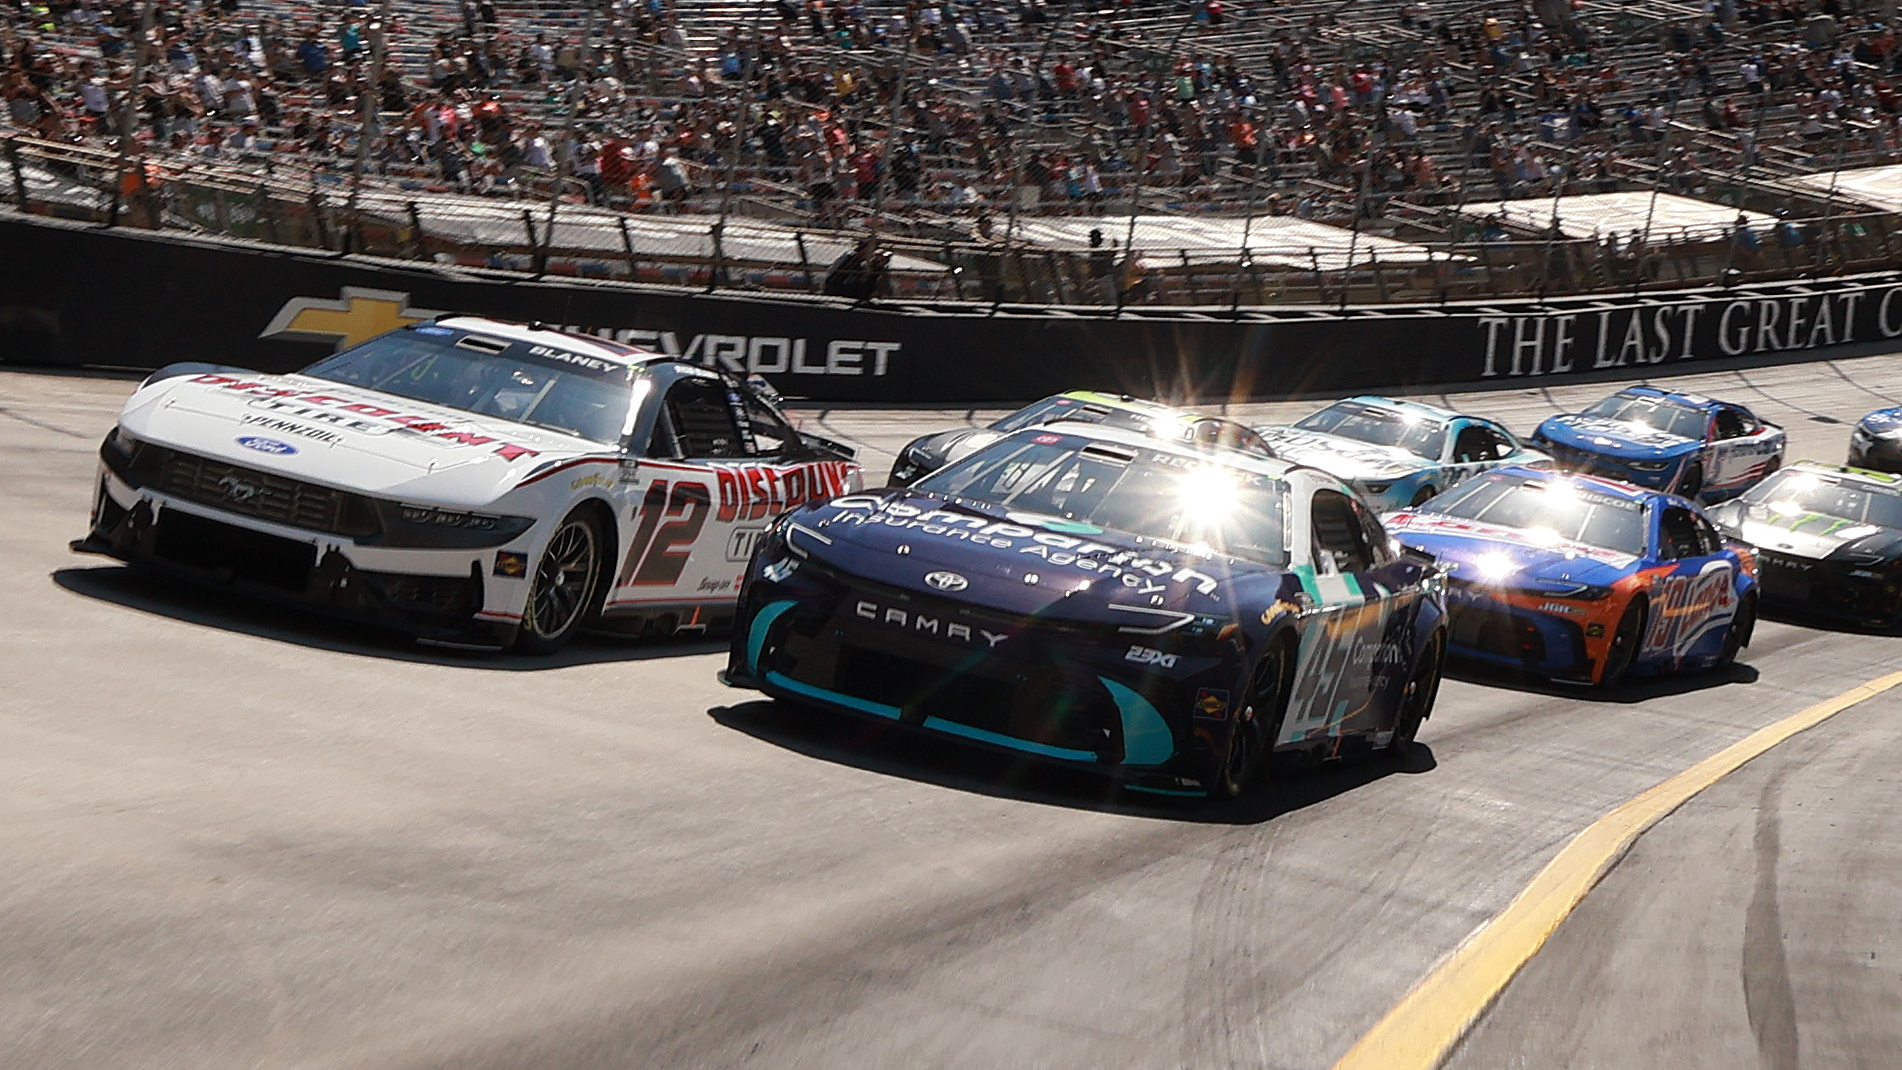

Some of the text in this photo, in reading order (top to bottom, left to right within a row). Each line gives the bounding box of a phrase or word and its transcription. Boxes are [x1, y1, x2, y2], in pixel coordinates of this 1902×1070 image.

[1477, 314, 1576, 377] THE
[1592, 304, 1705, 369] LAST
[1717, 292, 1867, 357] GREAT
[528, 345, 620, 375] BLANEY
[241, 436, 293, 455] Ford
[250, 415, 338, 445] PENNZOIL
[615, 478, 712, 589] 12
[830, 494, 1219, 596] Comparion
[831, 510, 1013, 549] Insurance
[1017, 541, 1167, 594] Agency
[856, 600, 1009, 648] CAMRY
